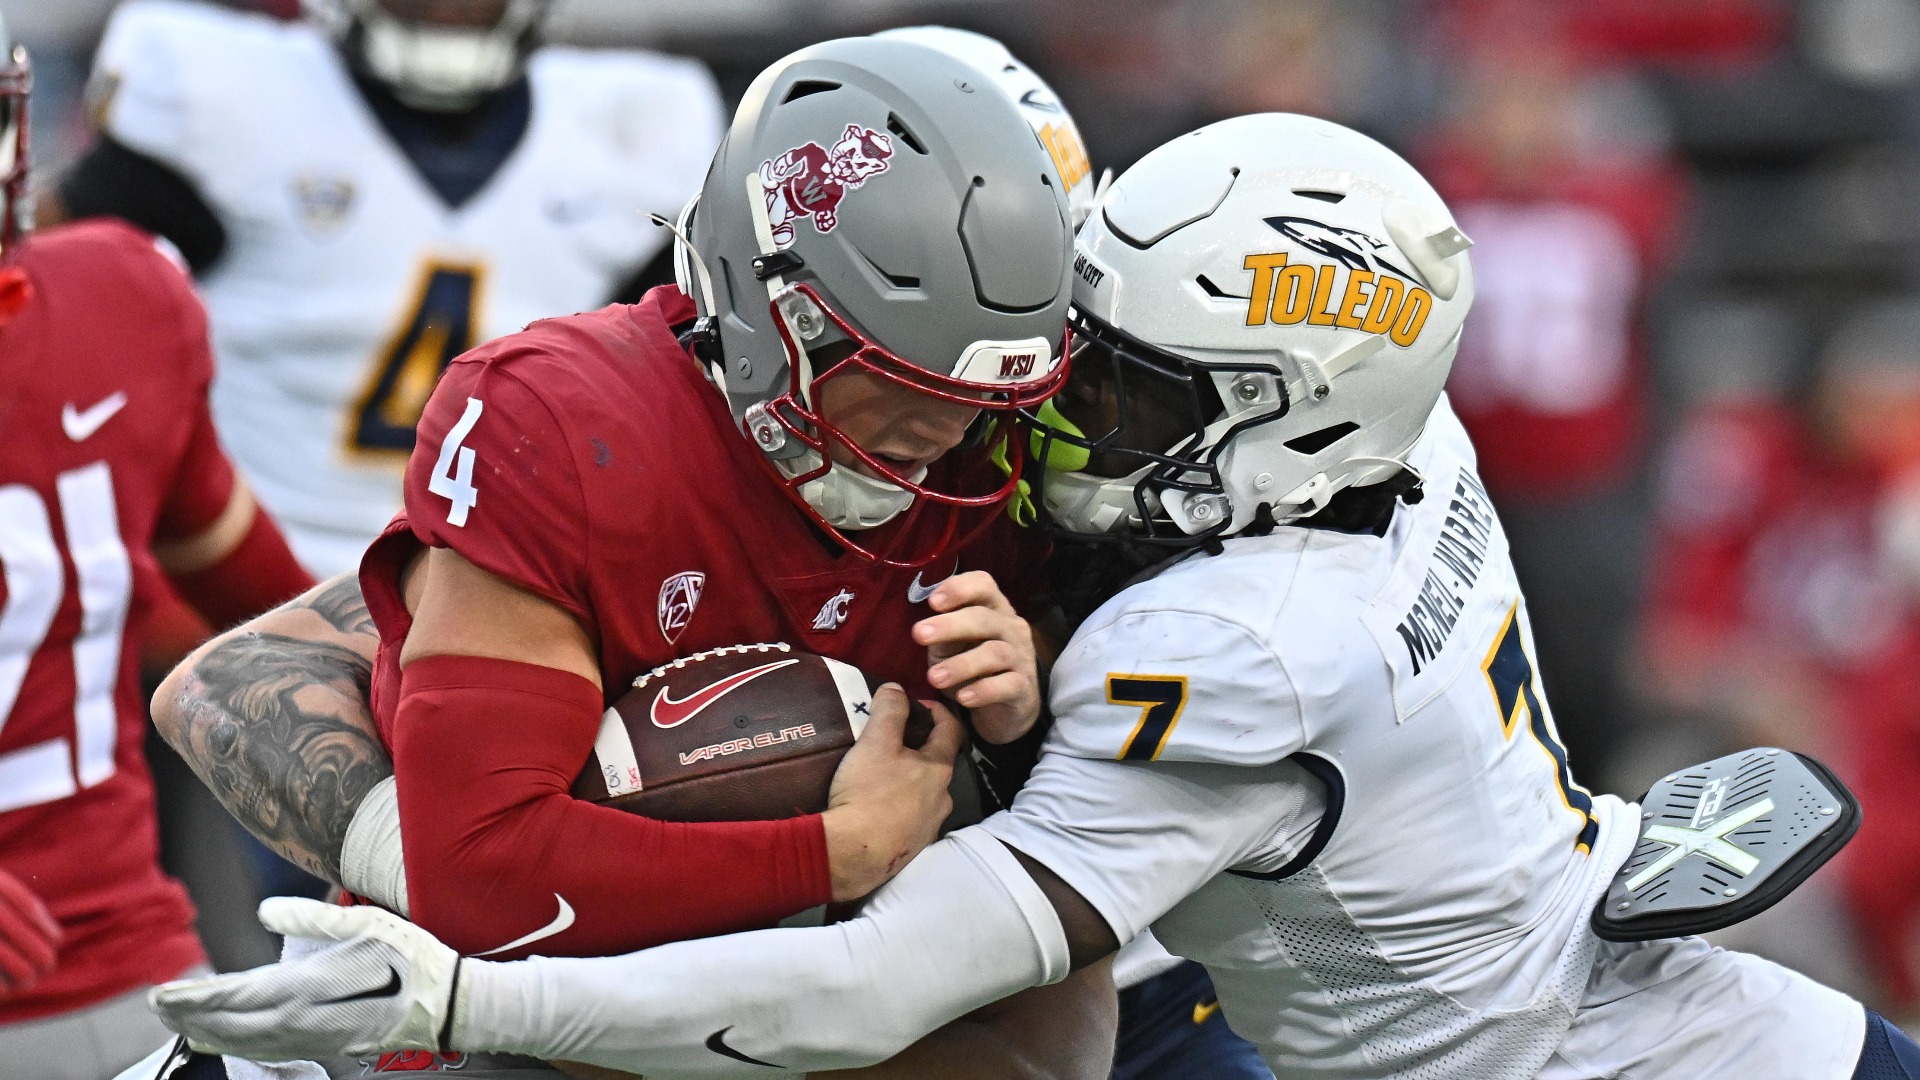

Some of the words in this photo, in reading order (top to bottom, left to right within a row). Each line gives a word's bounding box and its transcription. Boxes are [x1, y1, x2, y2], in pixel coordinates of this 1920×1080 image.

[801, 176, 828, 205] W
[1083, 263, 1104, 288] CITY
[1243, 252, 1433, 348] TOLEDO
[343, 256, 488, 466] 4
[1000, 353, 1036, 377] WSU
[428, 396, 483, 528] 4
[661, 575, 702, 618] PAC
[665, 602, 687, 630] 12
[0, 459, 133, 813] 21
[1104, 672, 1188, 761] 7
[679, 737, 754, 766] VAPOR
[752, 722, 817, 749] ELITE
